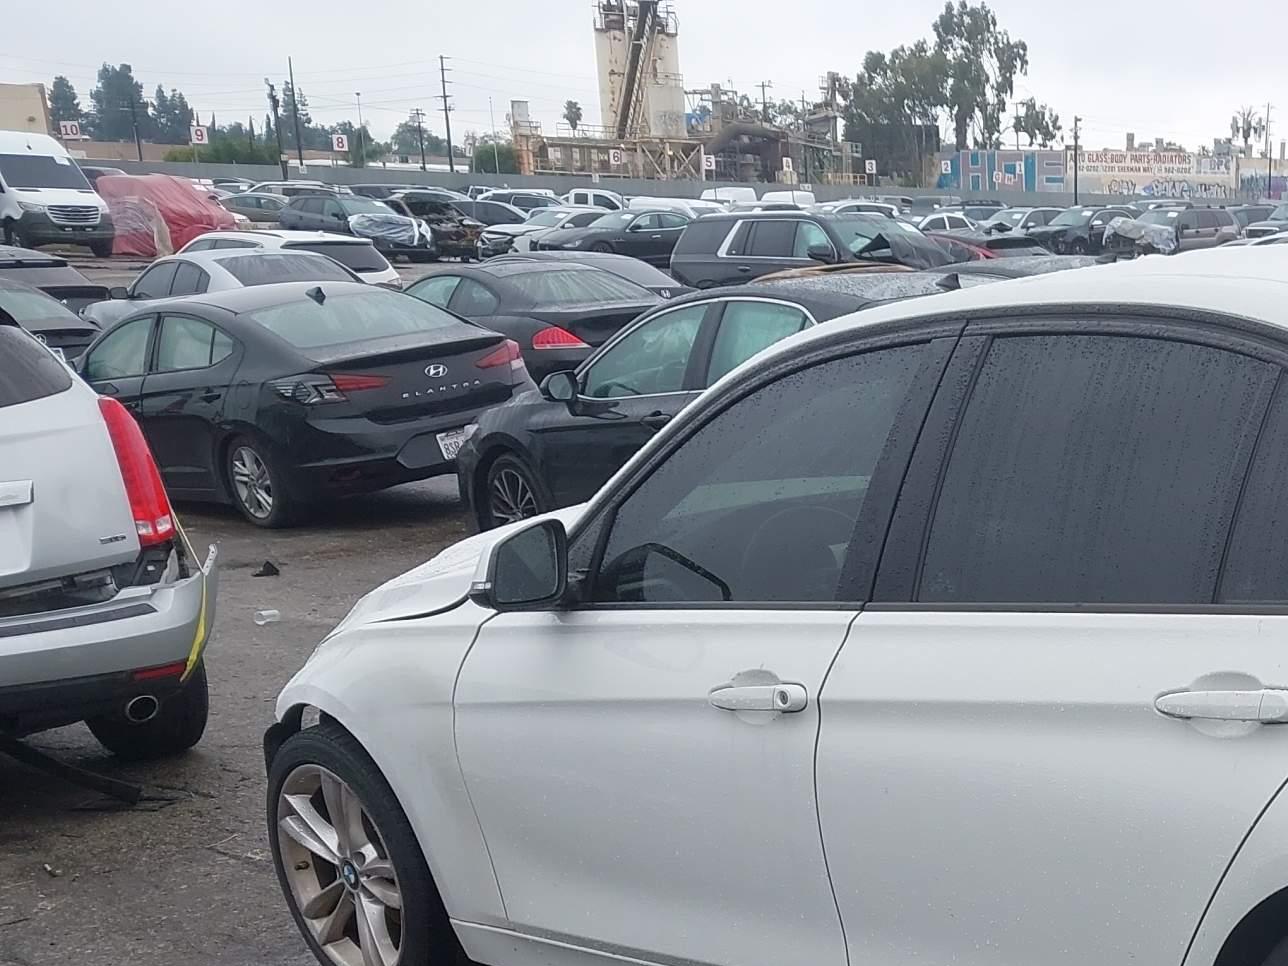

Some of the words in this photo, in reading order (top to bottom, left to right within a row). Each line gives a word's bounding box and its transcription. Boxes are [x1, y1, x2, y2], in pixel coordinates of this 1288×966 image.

[63, 124, 79, 136] 10
[195, 128, 204, 142] 9
[336, 137, 344, 149] 8
[612, 151, 621, 162] 6
[705, 156, 713, 168] 5
[867, 161, 874, 172] 3
[943, 161, 950, 172] 2
[402, 380, 480, 398] ELANTRA
